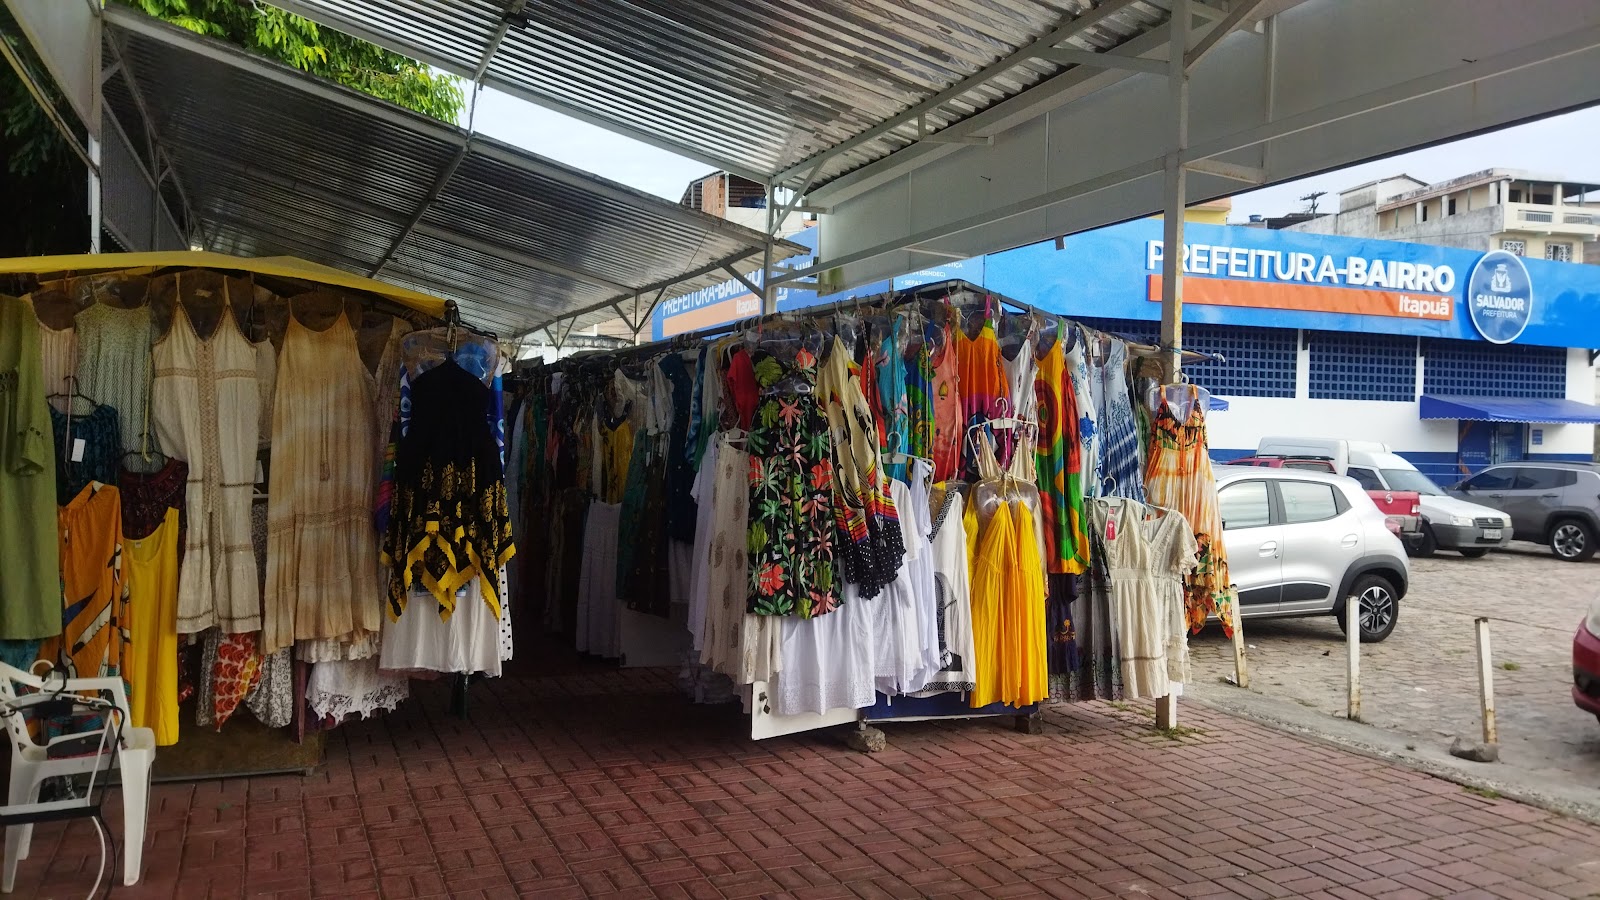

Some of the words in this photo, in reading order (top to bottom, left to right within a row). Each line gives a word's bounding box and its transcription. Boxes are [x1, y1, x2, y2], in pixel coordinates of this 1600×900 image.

[1399, 295, 1450, 317] Itapuã
[1476, 294, 1524, 311] SALVADOR
[1482, 309, 1517, 319] PREFEITURA
